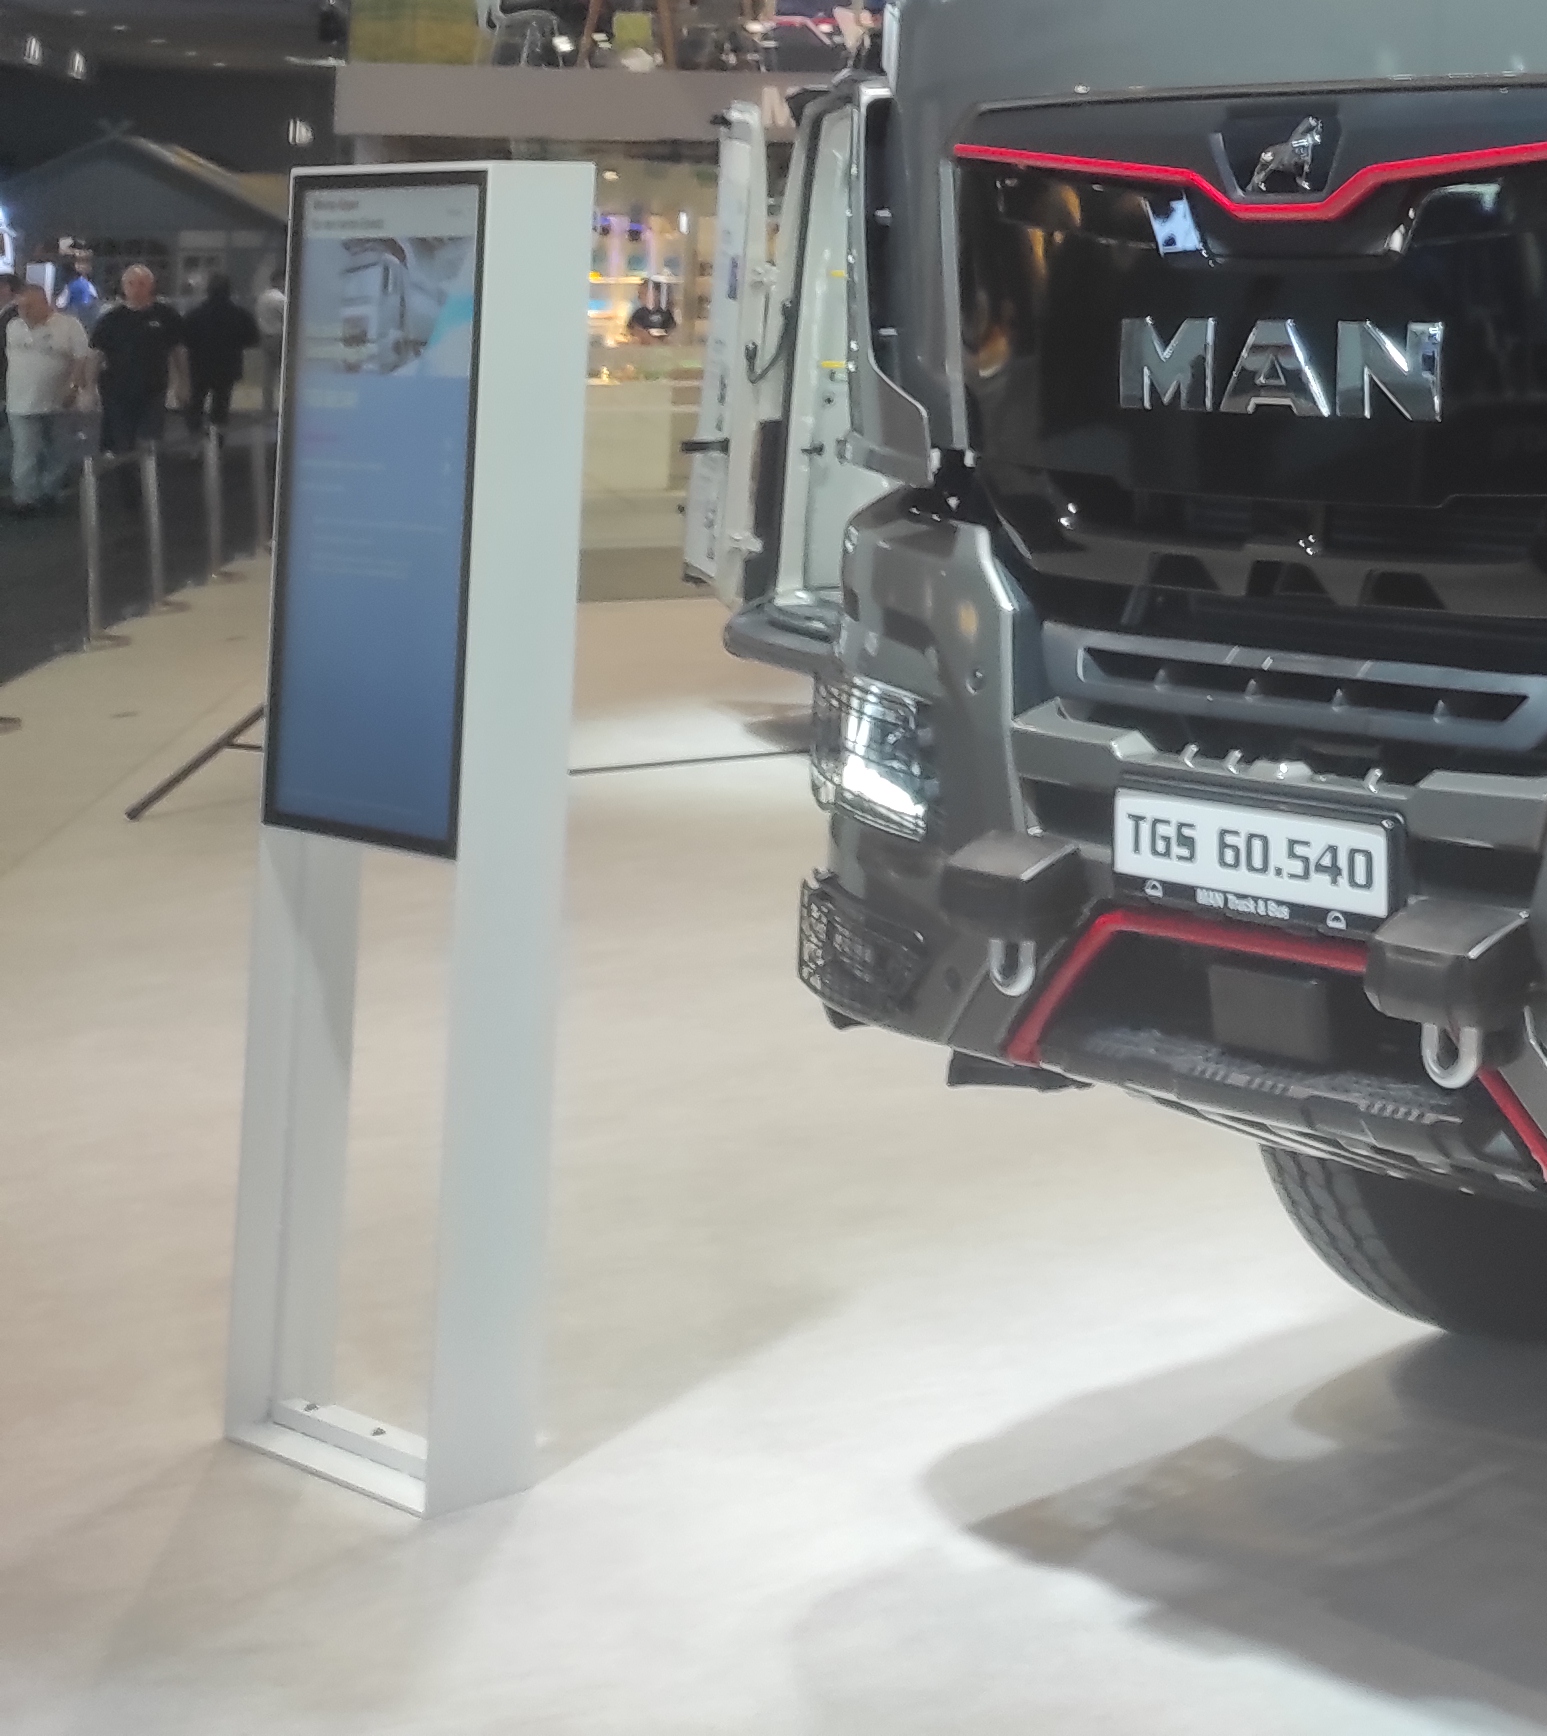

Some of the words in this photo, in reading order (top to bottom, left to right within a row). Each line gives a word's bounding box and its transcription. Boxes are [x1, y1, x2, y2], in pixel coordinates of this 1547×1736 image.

[1119, 315, 1446, 423] MAN
[1126, 813, 1196, 863] TGS
[1218, 827, 1374, 891] 60.540
